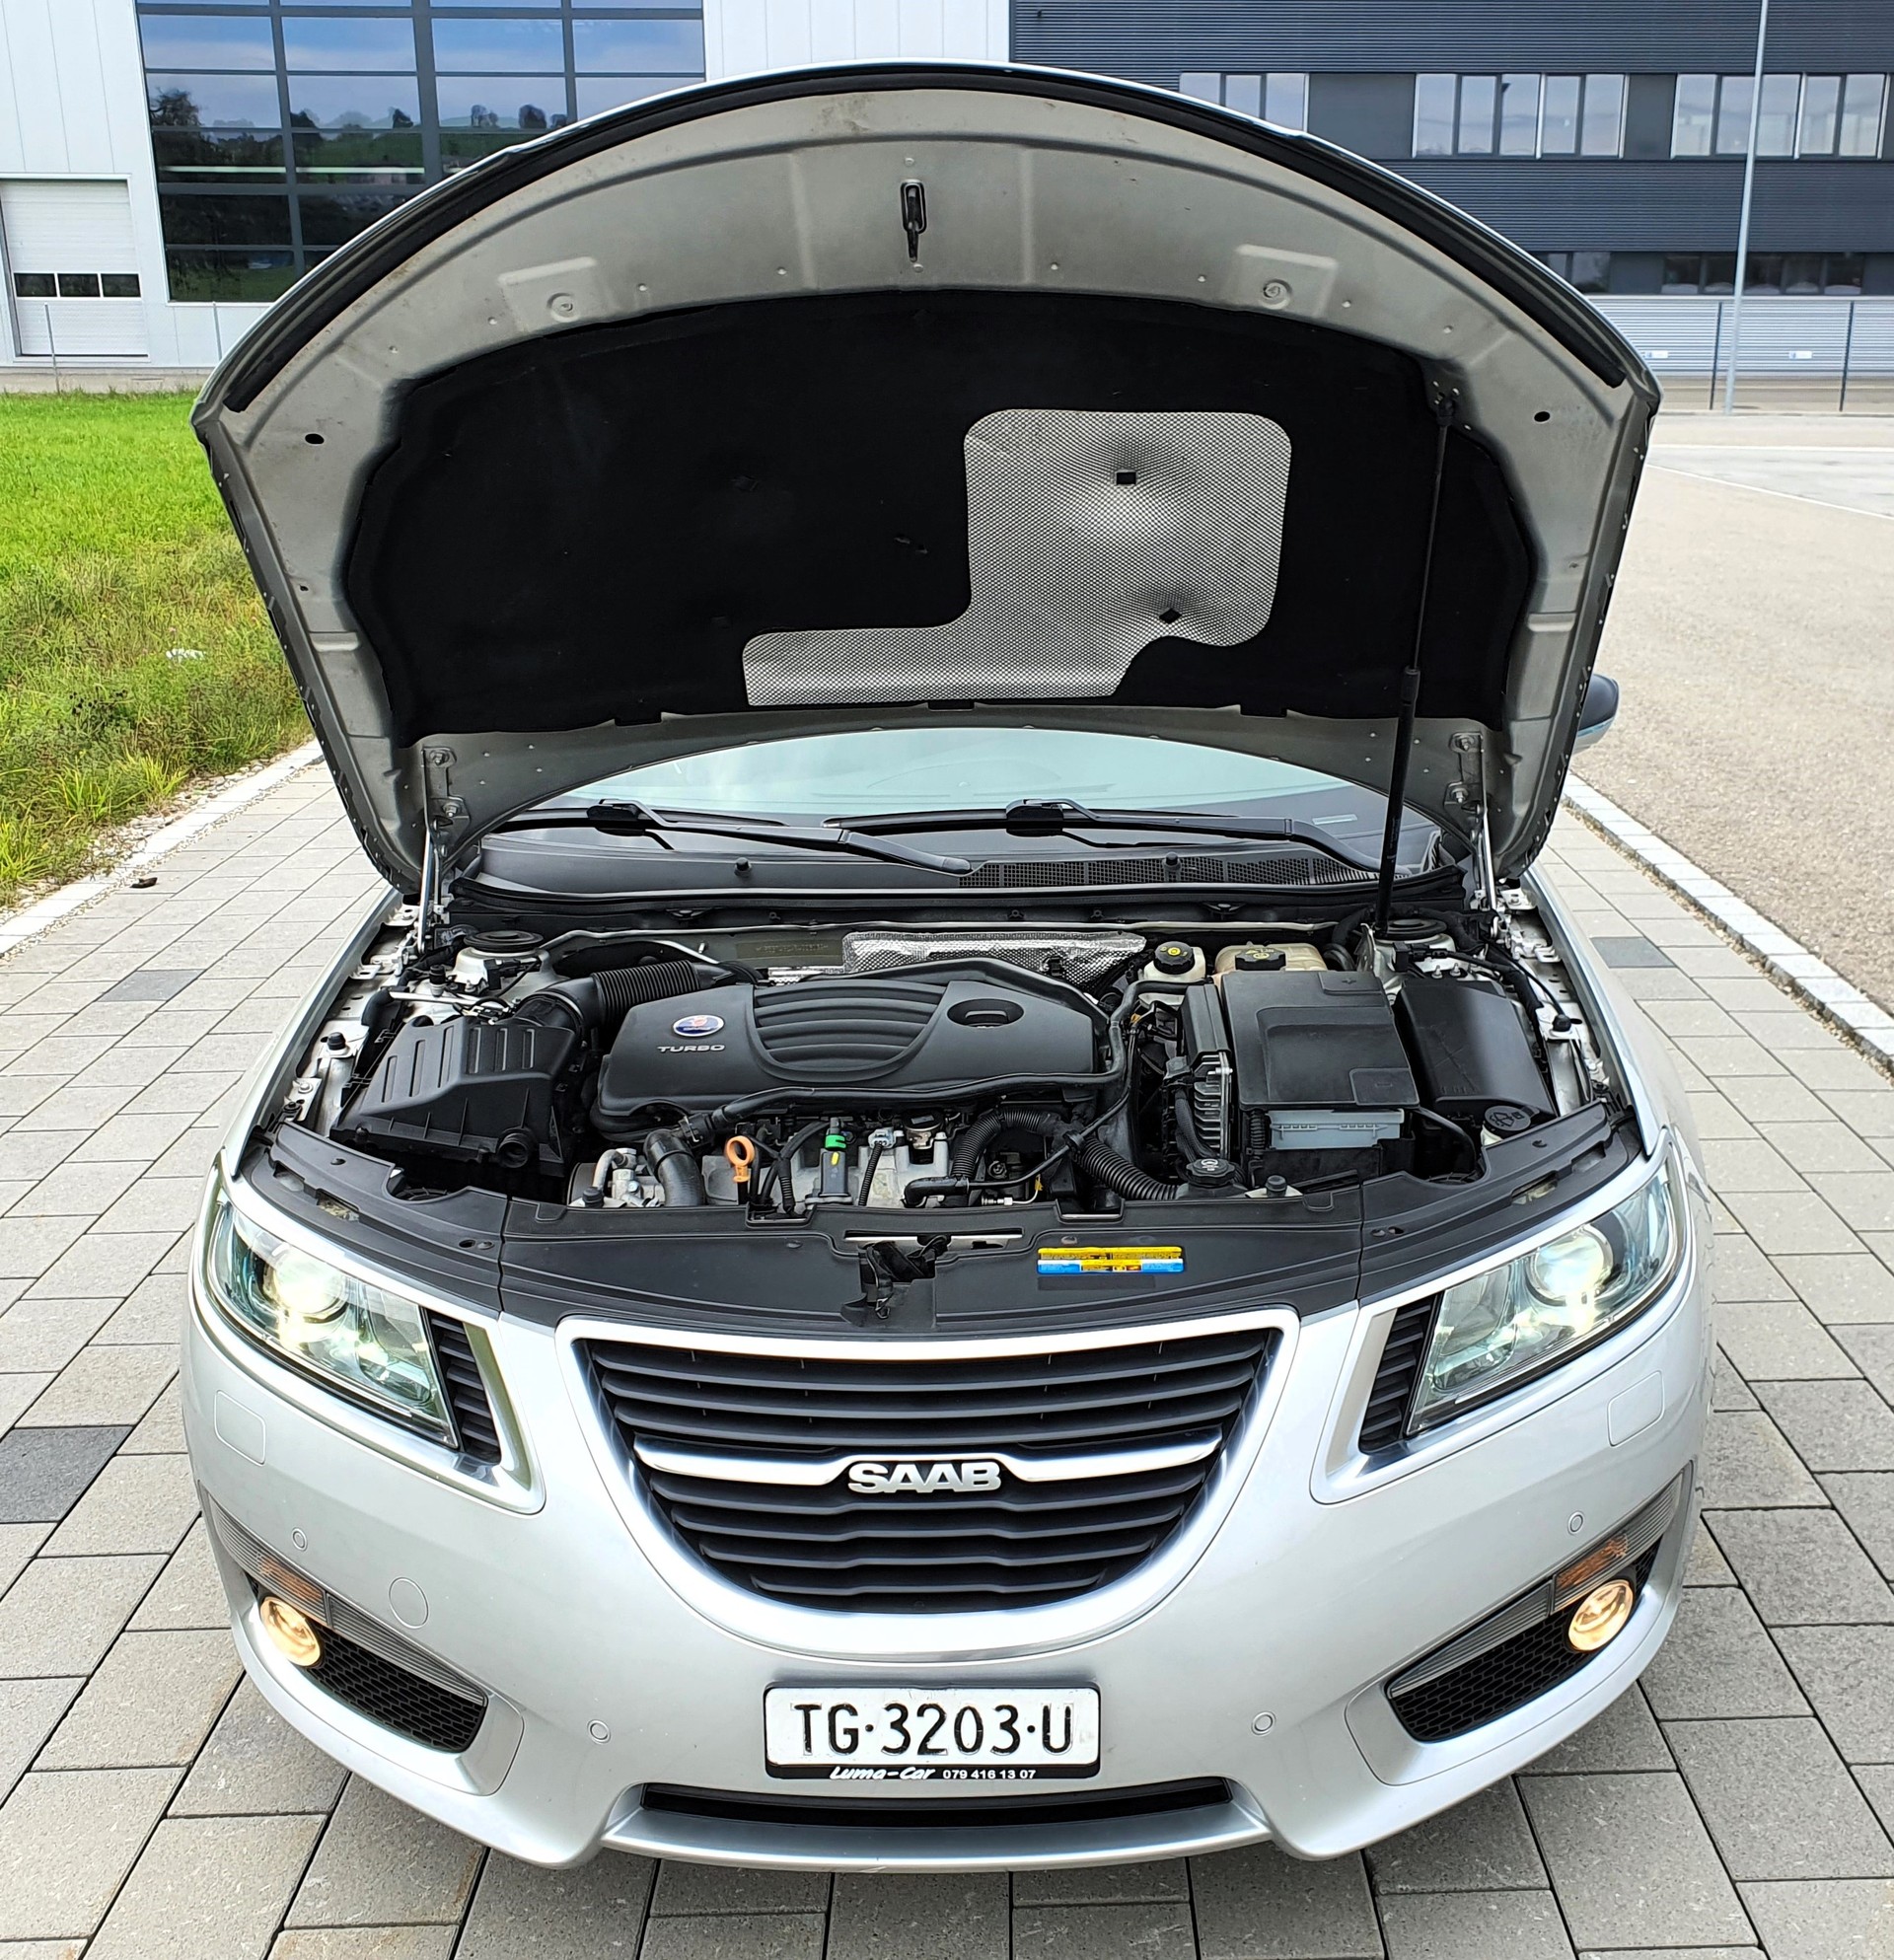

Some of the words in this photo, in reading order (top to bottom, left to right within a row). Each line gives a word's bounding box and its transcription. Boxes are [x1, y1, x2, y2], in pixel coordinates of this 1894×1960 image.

[847, 1461, 1001, 1493] SAAB
[830, 1766, 936, 1779] Luma-Car
[943, 1770, 968, 1779] 079
[971, 1770, 995, 1779] 416
[999, 1770, 1015, 1779] 13
[1020, 1770, 1036, 1779] 07
